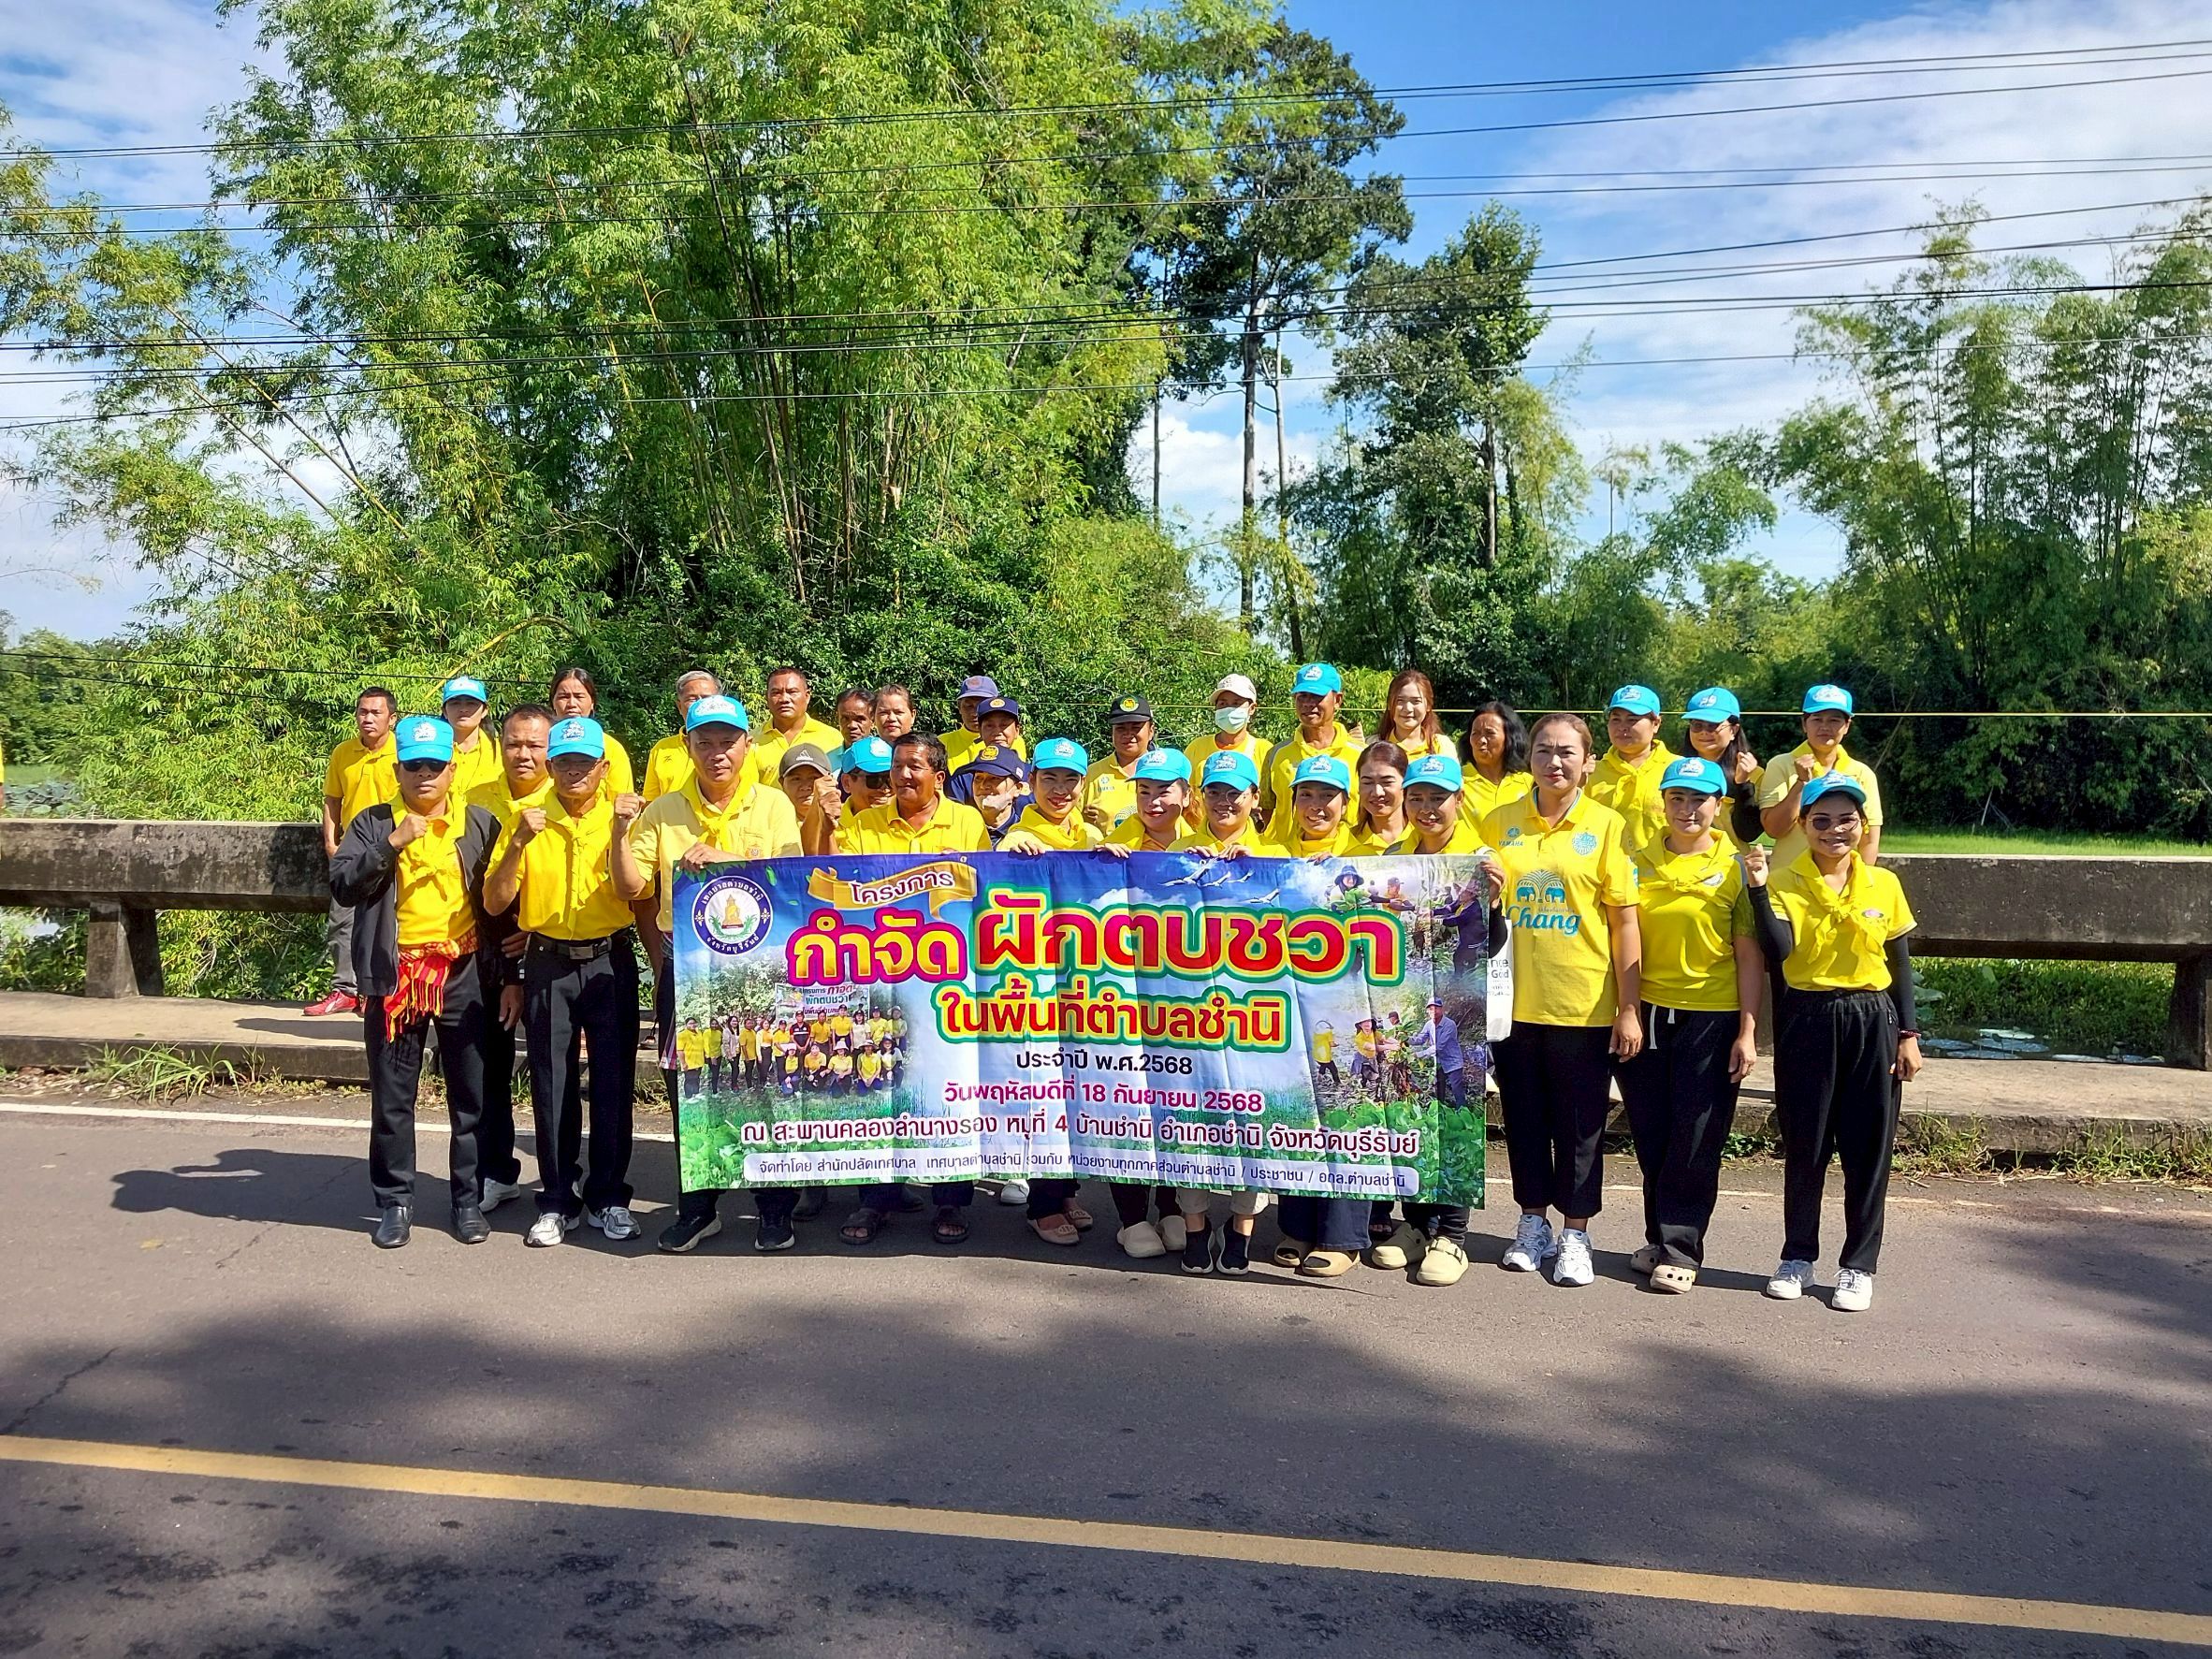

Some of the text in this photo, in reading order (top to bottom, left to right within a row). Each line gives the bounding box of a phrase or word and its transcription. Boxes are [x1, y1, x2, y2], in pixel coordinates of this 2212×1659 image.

[851, 870, 954, 904] โครงการ
[792, 891, 1395, 980] กำจัด ผักตบชวา
[1506, 905, 1582, 936] Chang
[941, 977, 1282, 1041] ในพื้นที่ตำบลชำนิ
[1016, 1046, 1193, 1075] ประจำปี พ.ศ.2568
[944, 1074, 1262, 1112] วันพฤหัสบดีที่ 18 กันยายน 2568
[743, 1108, 1418, 1158] ณ สะพานคลองลำนางรอง หมูที่ 4 บ้านชำนิ อำเภอชำนิ จังหวัดบุรีรัมย์
[759, 1157, 812, 1173] จัดทำโดย
[818, 1157, 916, 1172] สำนักปลัดเทศบาล
[1250, 1167, 1302, 1182] ประชาชน
